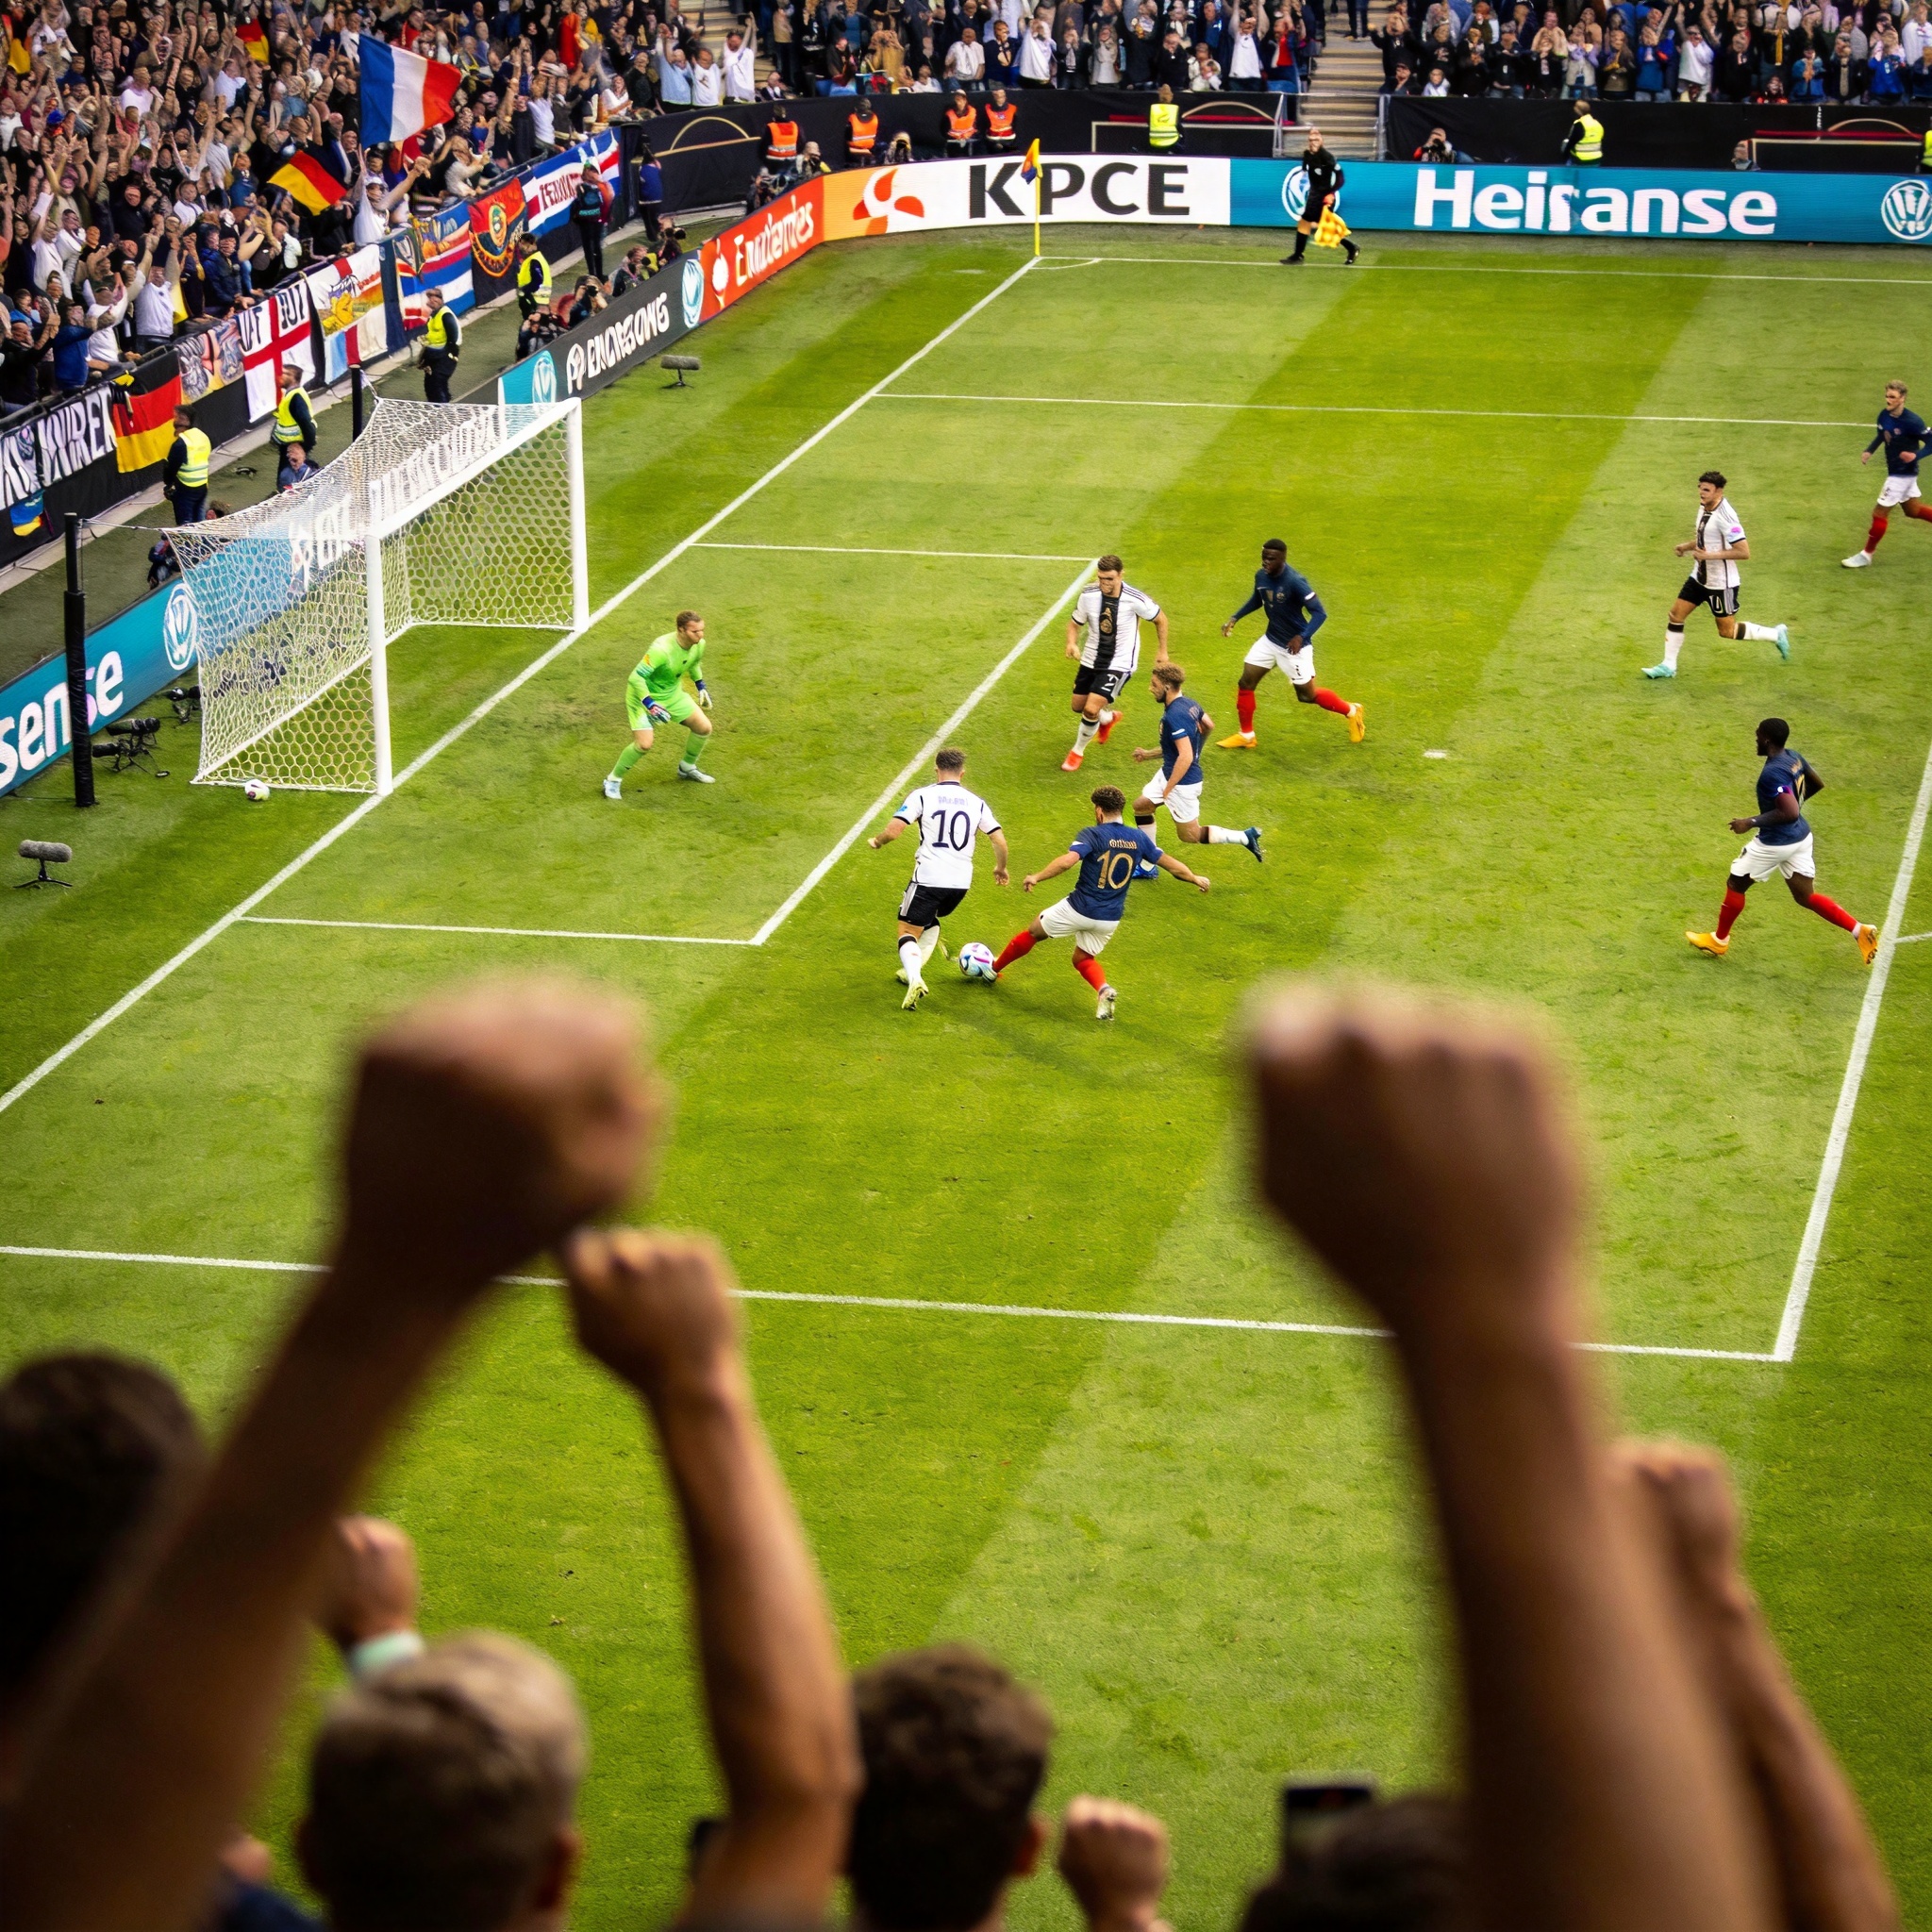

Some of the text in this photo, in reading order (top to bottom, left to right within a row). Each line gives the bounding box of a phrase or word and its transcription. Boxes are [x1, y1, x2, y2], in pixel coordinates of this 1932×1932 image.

[968, 161, 1191, 219] KPCE
[931, 809, 971, 851] 10
[1096, 849, 1134, 890] 10
